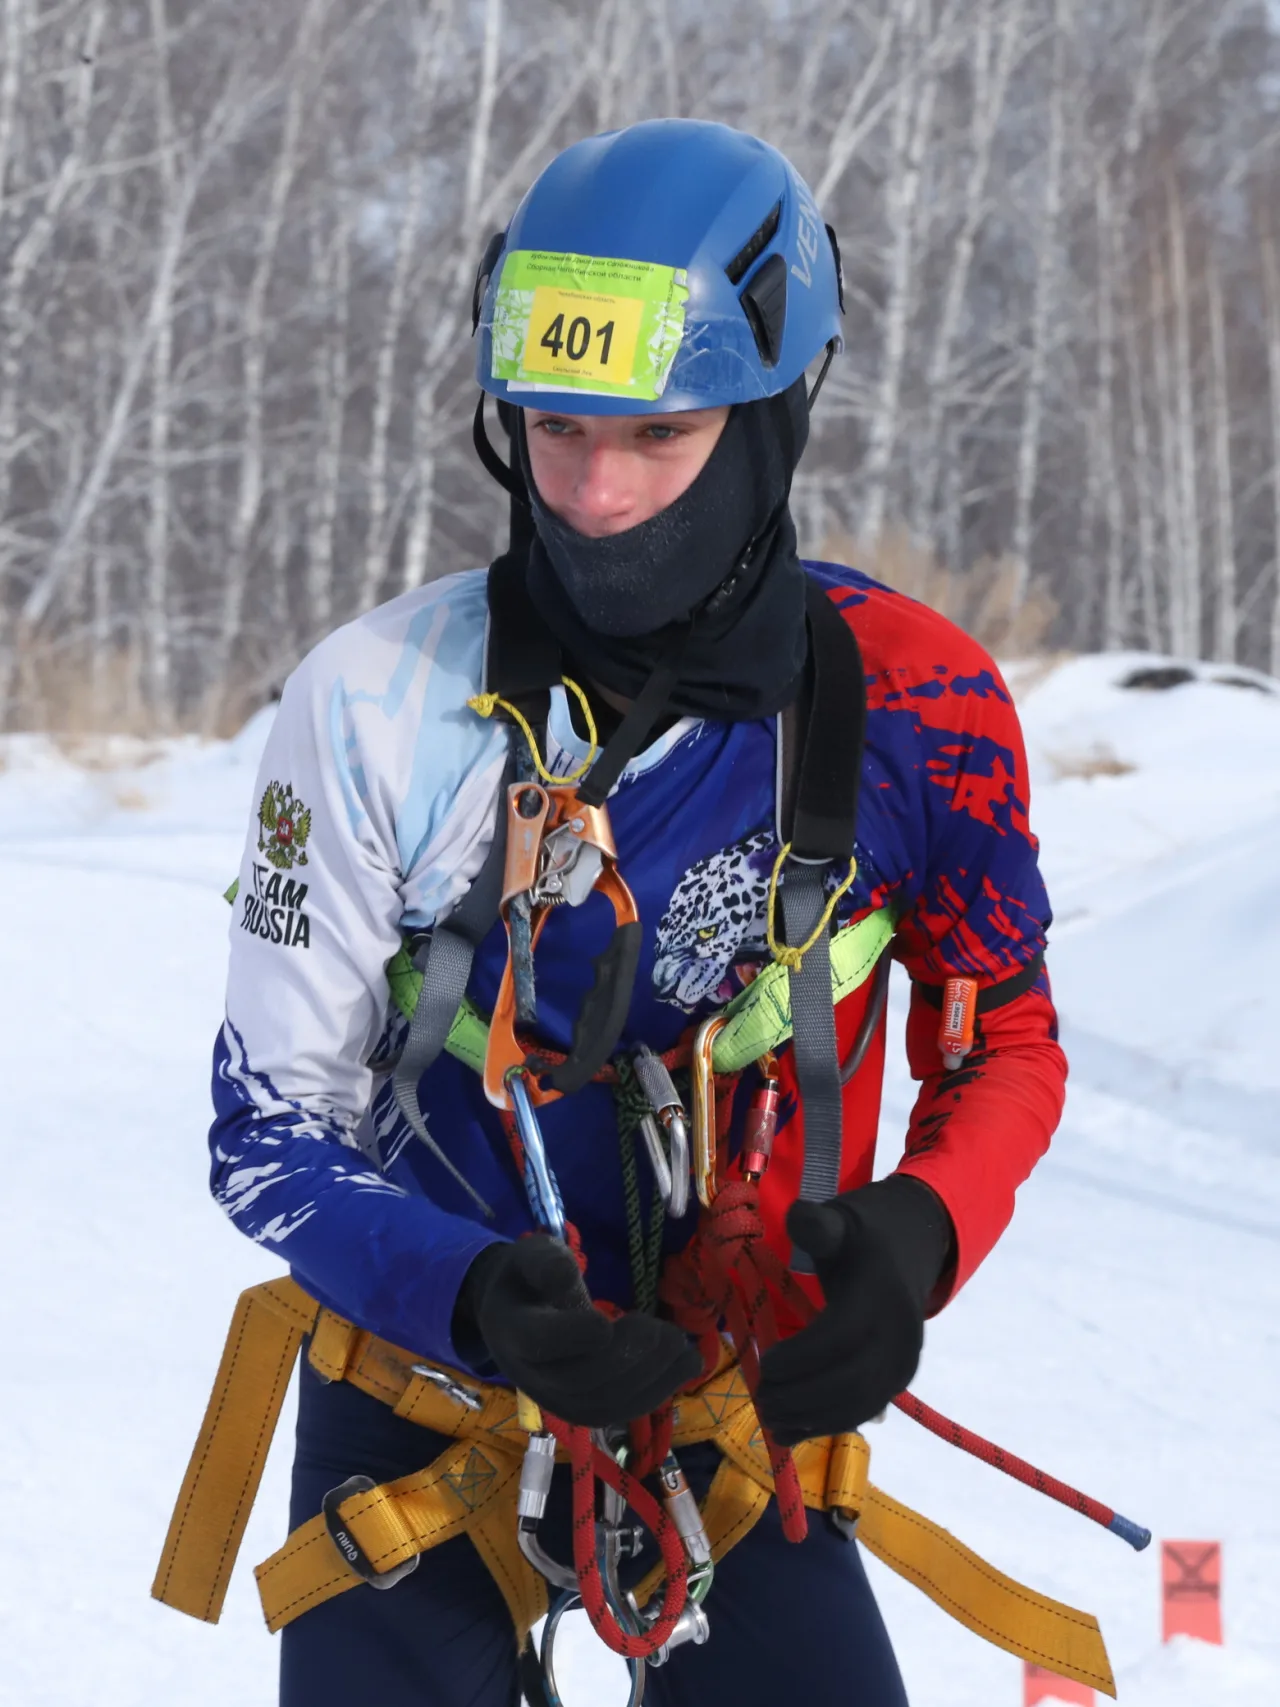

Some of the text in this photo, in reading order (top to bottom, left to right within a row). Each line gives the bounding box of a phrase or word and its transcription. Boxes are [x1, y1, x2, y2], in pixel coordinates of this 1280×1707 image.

[607, 271, 641, 282] области
[540, 313, 615, 365] 401
[252, 861, 309, 911] TEAM
[240, 894, 310, 949] RUSSIA
